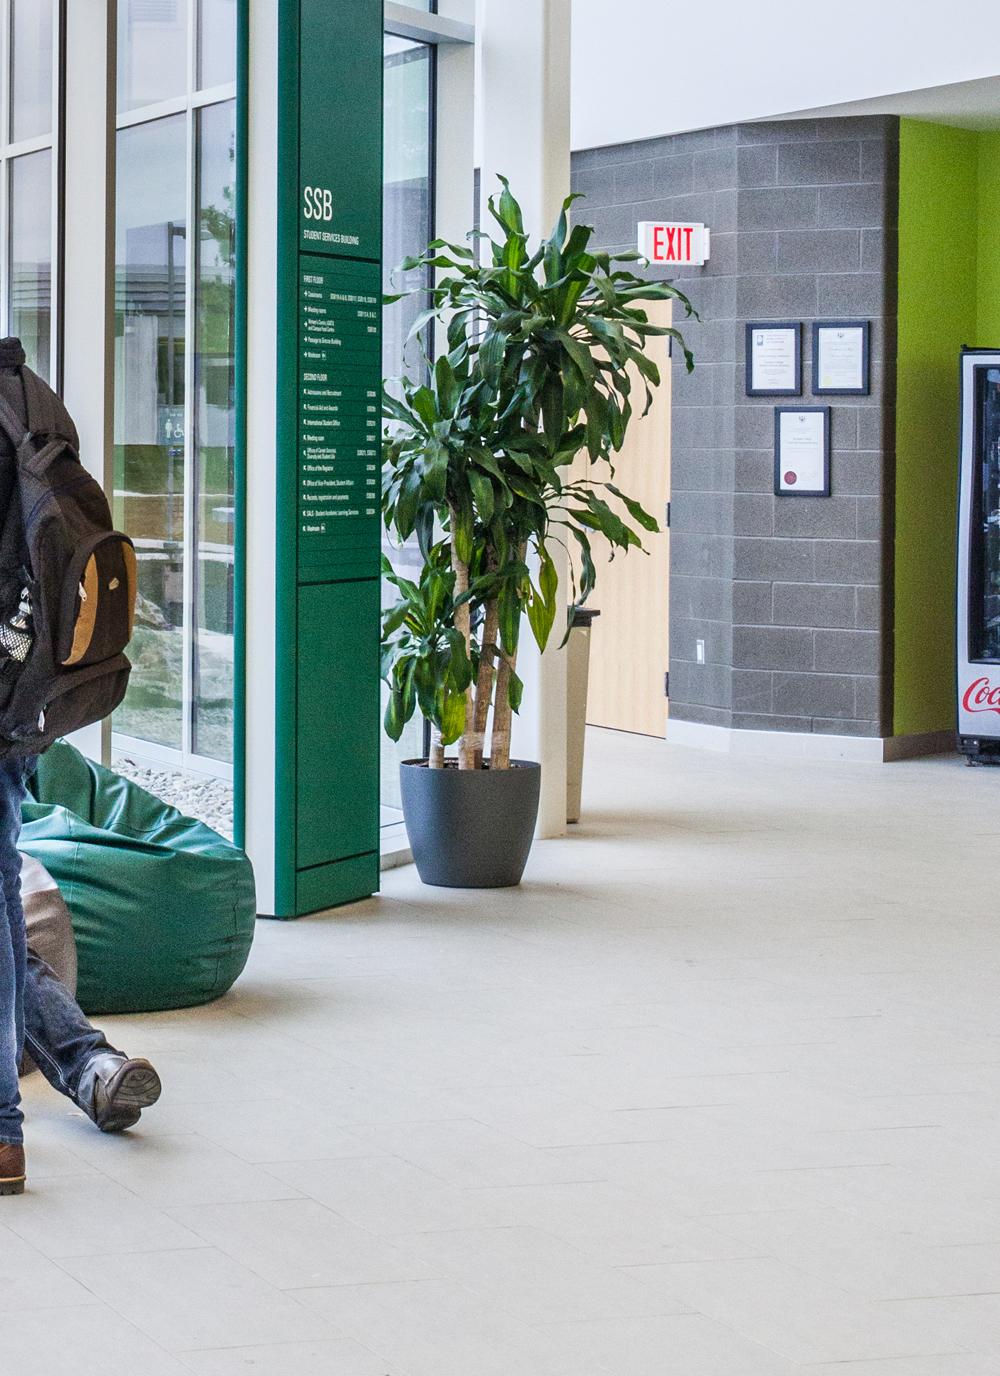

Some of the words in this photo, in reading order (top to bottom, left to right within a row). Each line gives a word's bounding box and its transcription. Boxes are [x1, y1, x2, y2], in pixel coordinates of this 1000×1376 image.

[303, 186, 333, 222] SSB
[303, 229, 322, 241] STUDENT
[322, 231, 340, 244] SERVICES
[341, 234, 359, 246] BUILDING
[653, 226, 694, 261] EXIT
[962, 677, 1000, 714] Coc
